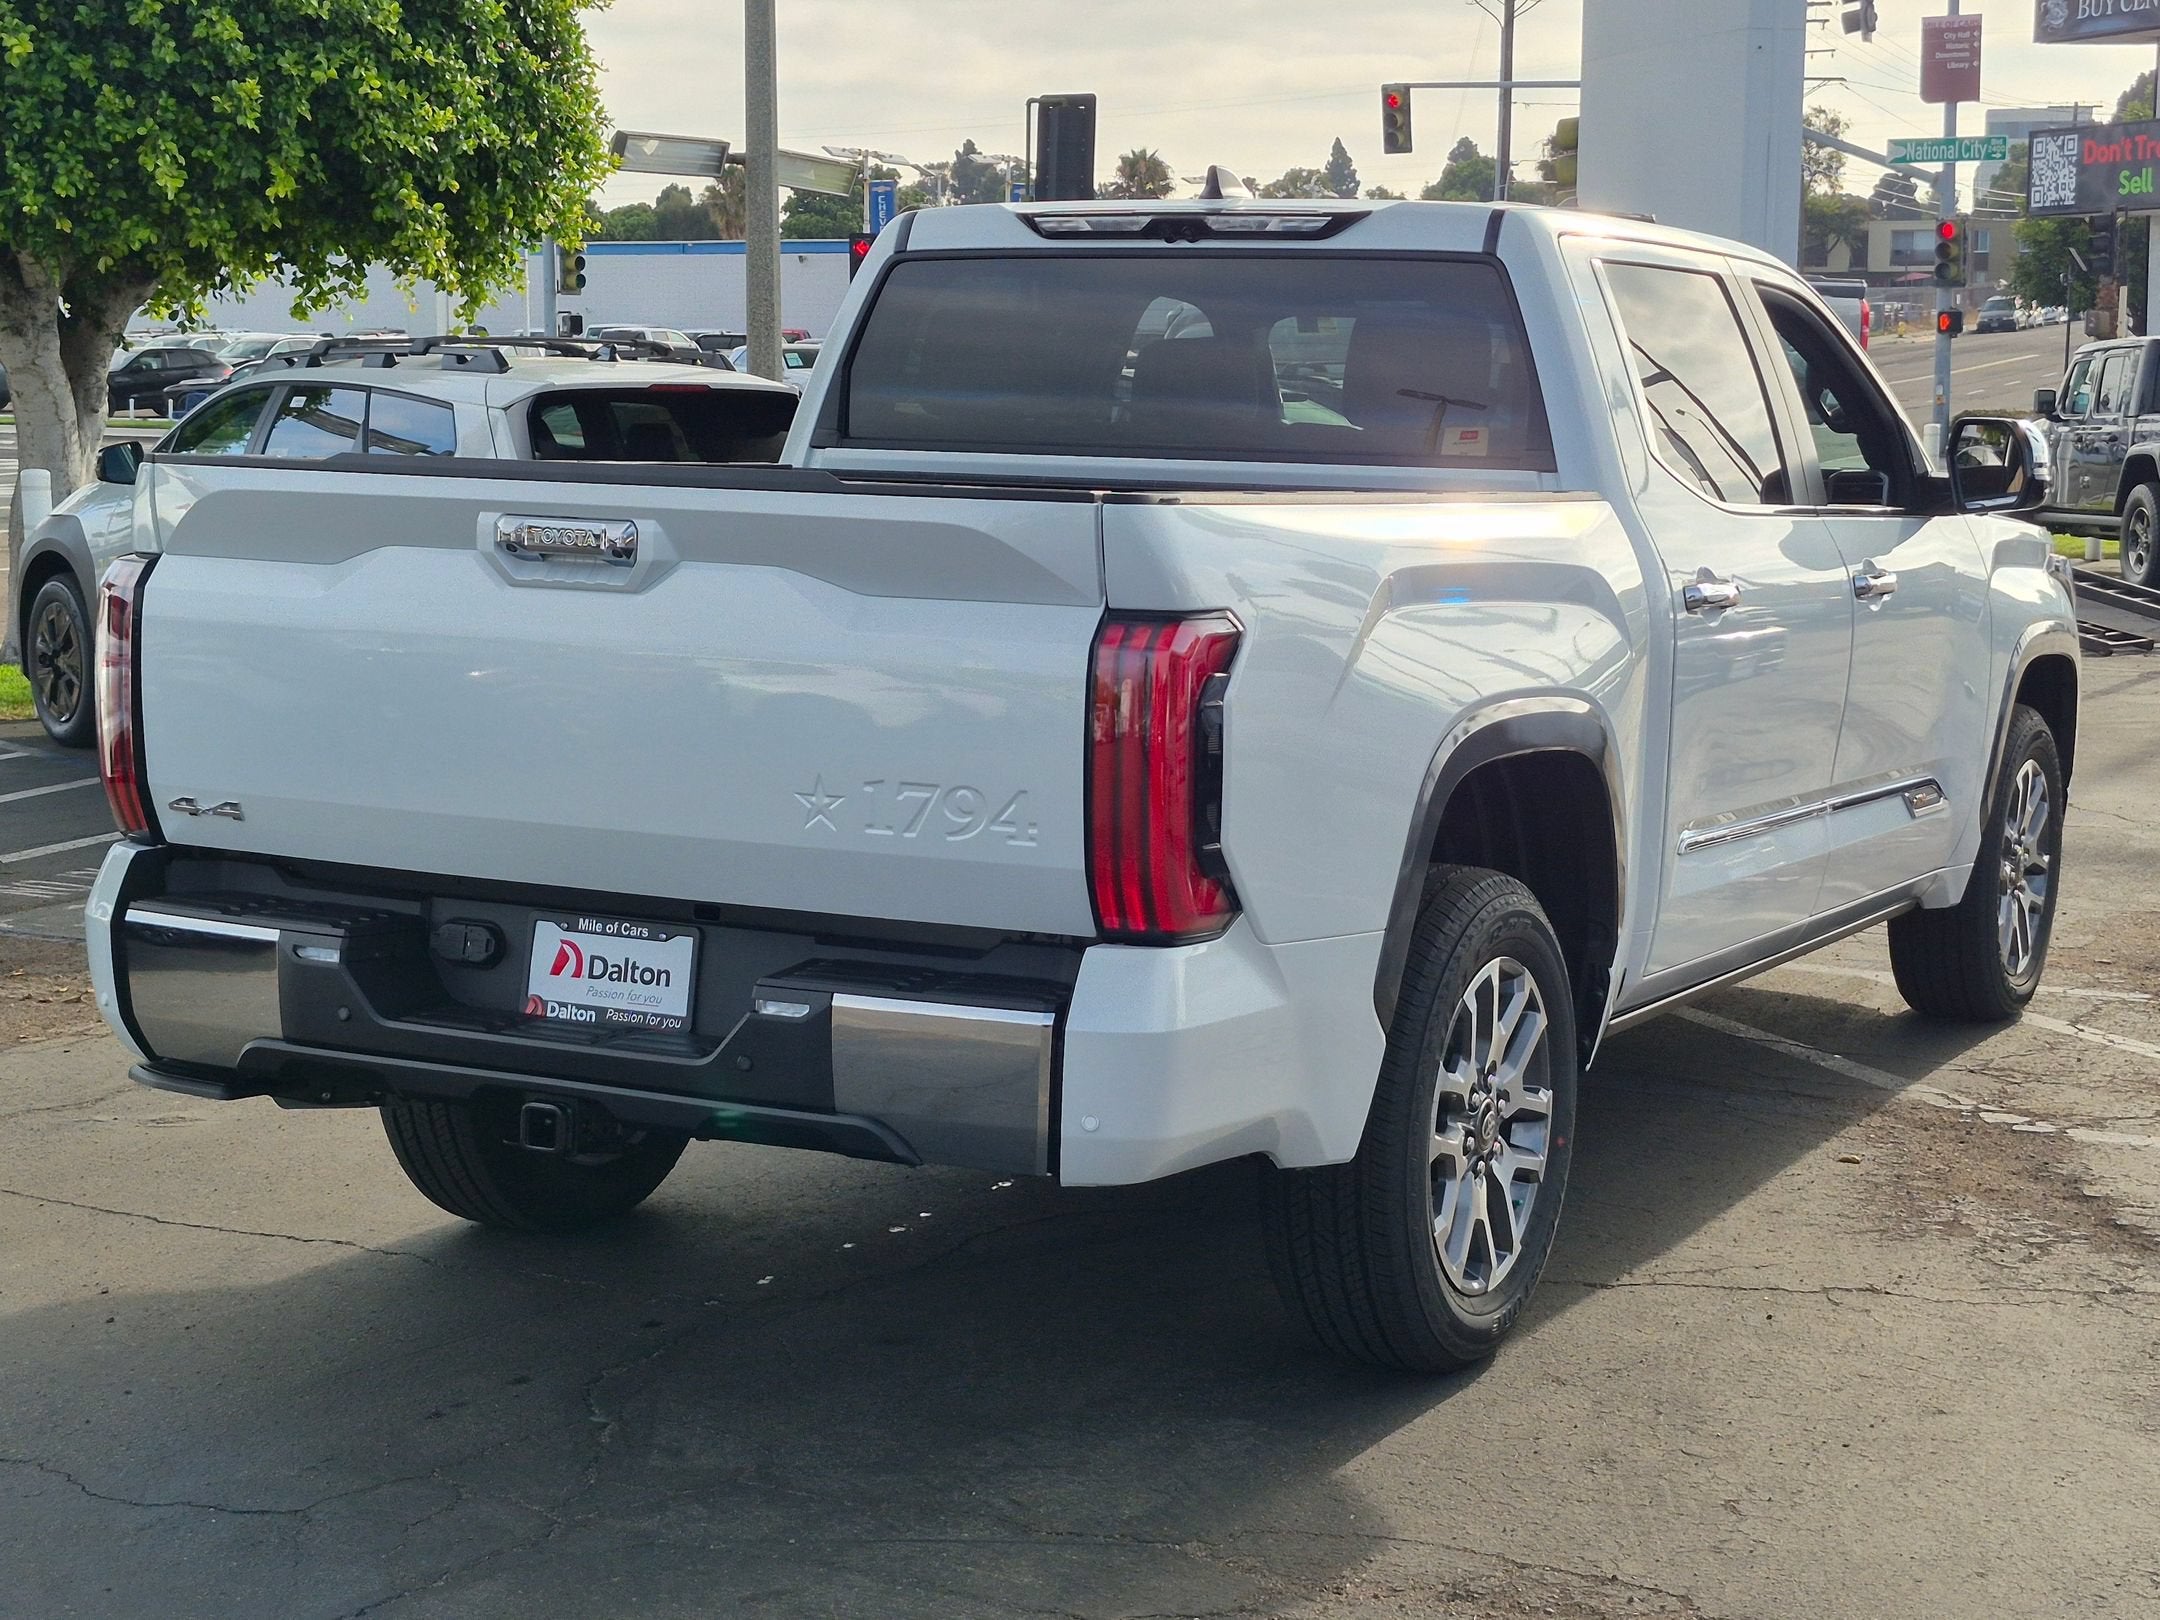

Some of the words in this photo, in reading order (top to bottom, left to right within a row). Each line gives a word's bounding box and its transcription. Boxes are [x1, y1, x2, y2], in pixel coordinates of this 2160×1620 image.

[2076, 0, 2114, 19] BUY
[1943, 32, 1957, 41] City
[1906, 140, 1959, 160] National
[1961, 139, 1987, 160] City
[2083, 136, 2132, 165] Don't
[2135, 134, 2160, 160] Tr
[2118, 167, 2153, 195] Sell
[532, 527, 597, 547] TOYOTA
[863, 778, 1038, 847] 1794
[578, 917, 603, 932] Mile
[605, 921, 619, 934] of
[621, 922, 649, 938] Cars
[587, 954, 671, 987] Dalton
[586, 985, 625, 1001] Passion
[626, 989, 643, 1003] for
[643, 994, 663, 1006] you
[546, 1001, 596, 1023] Dalton
[605, 1008, 644, 1025] Passion
[645, 1012, 662, 1027] for
[663, 1017, 682, 1029] you
